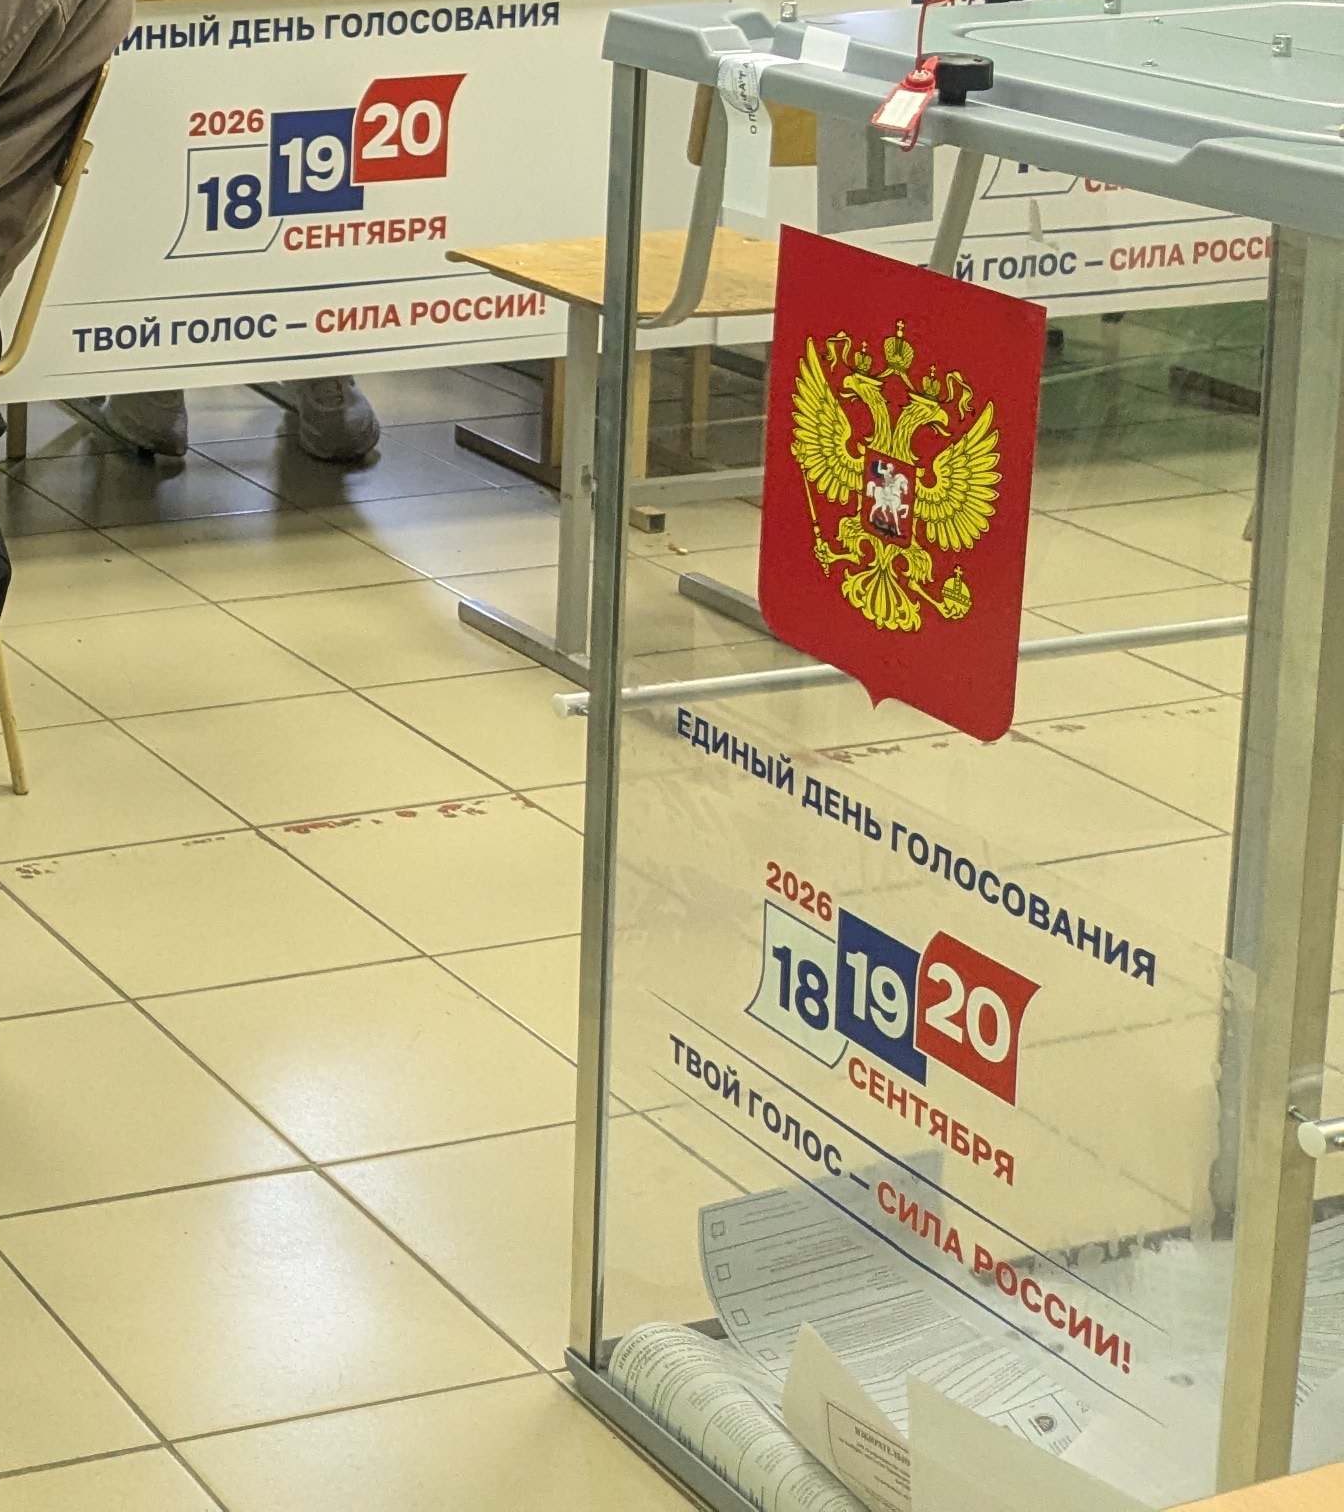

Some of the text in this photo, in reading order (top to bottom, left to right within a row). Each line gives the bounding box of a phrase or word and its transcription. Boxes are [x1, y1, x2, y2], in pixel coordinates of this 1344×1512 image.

[114, 1, 561, 56] ИНЫЙ ДЕНЬ ГОЛОСОВАНИЯ
[188, 108, 265, 138] 2026
[362, 100, 442, 159] 20
[279, 135, 347, 194] 19
[196, 174, 263, 232] 18
[283, 216, 448, 251] СЕНТЯБРЯ
[983, 251, 1077, 282] ГОЛОС
[1110, 243, 1185, 271] СИЛА
[72, 317, 161, 352] ТВОЙ
[170, 313, 278, 346] ГОЛОС
[315, 304, 402, 334] СИЛА
[410, 292, 548, 326] РОССИИ!
[676, 706, 1156, 987] ЕДИНЫЙ ДЕНЬ ГОЛОСОВАНИЯ
[764, 860, 834, 923] 2026
[771, 944, 1011, 1065] 18 19 20
[846, 1054, 1016, 1186] СЕНТЯБРЯ
[669, 1034, 741, 1109] ТВОЙ
[748, 1091, 843, 1178] ГОЛОС
[876, 1181, 964, 1266] СИЛА
[974, 1243, 1133, 1375] РОССИИ!
